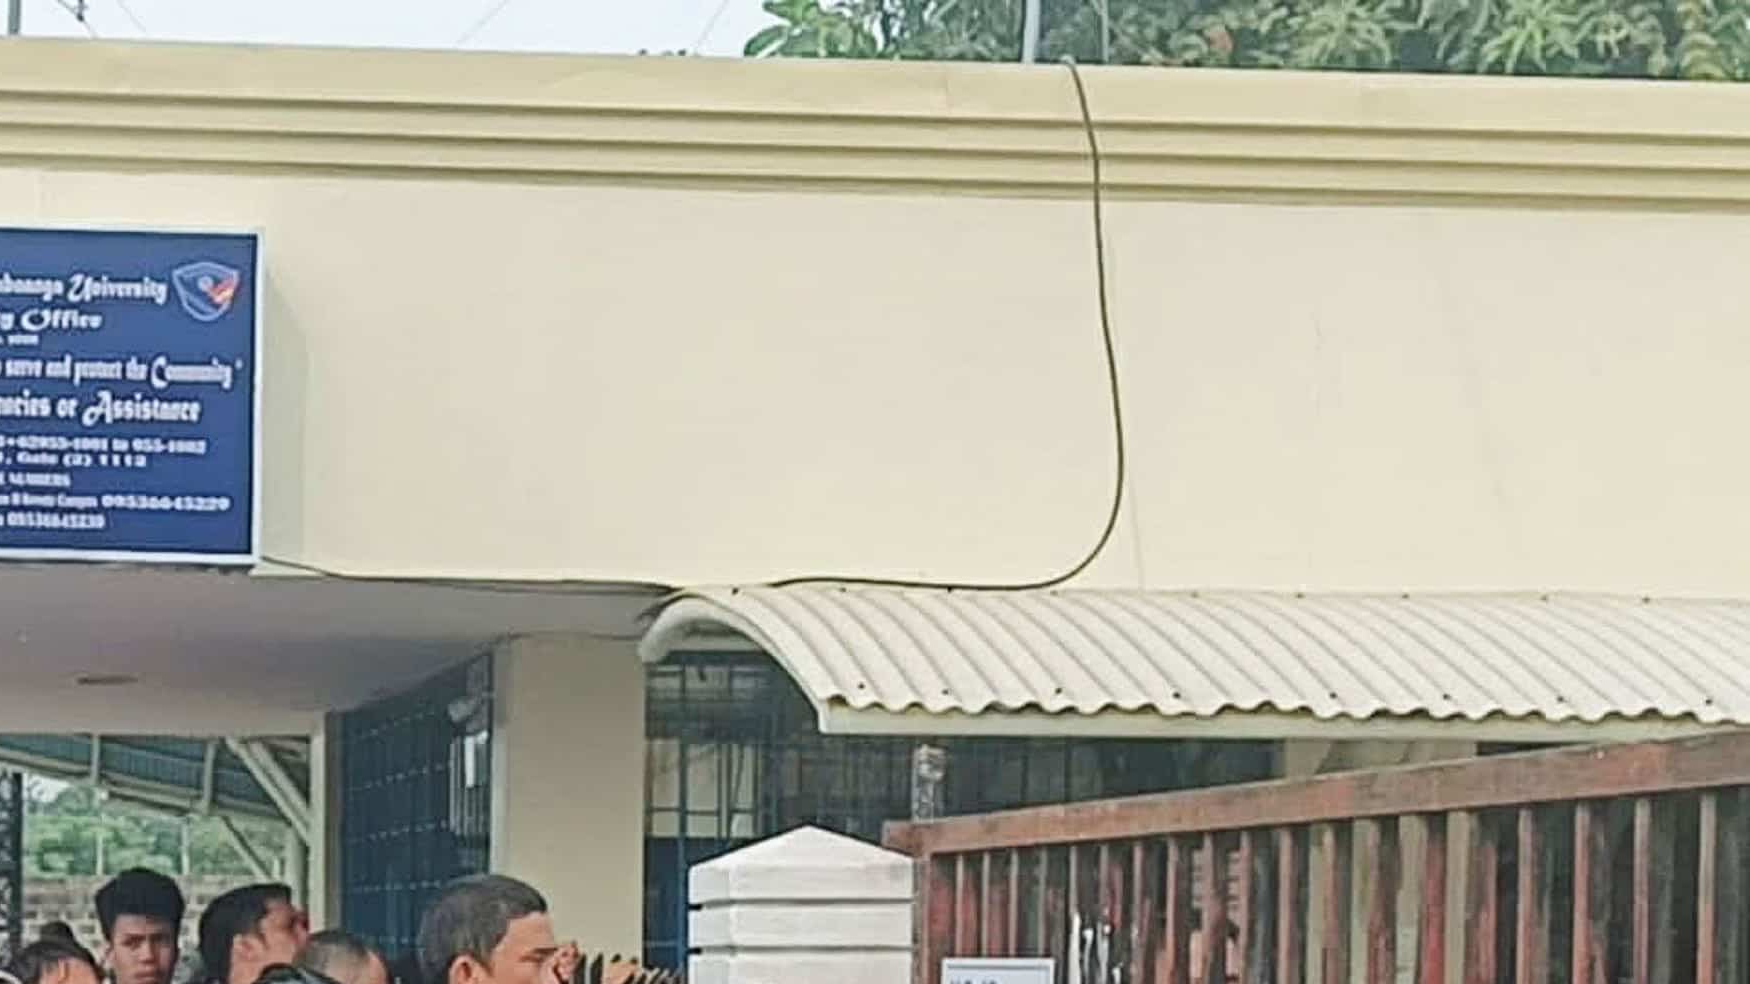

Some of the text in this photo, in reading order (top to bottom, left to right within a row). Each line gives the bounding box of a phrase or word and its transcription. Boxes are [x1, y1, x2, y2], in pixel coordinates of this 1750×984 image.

[68, 273, 168, 304] University
[21, 308, 102, 331] Office
[125, 356, 147, 380] the
[56, 398, 78, 418] or
[82, 390, 201, 426] Assistance
